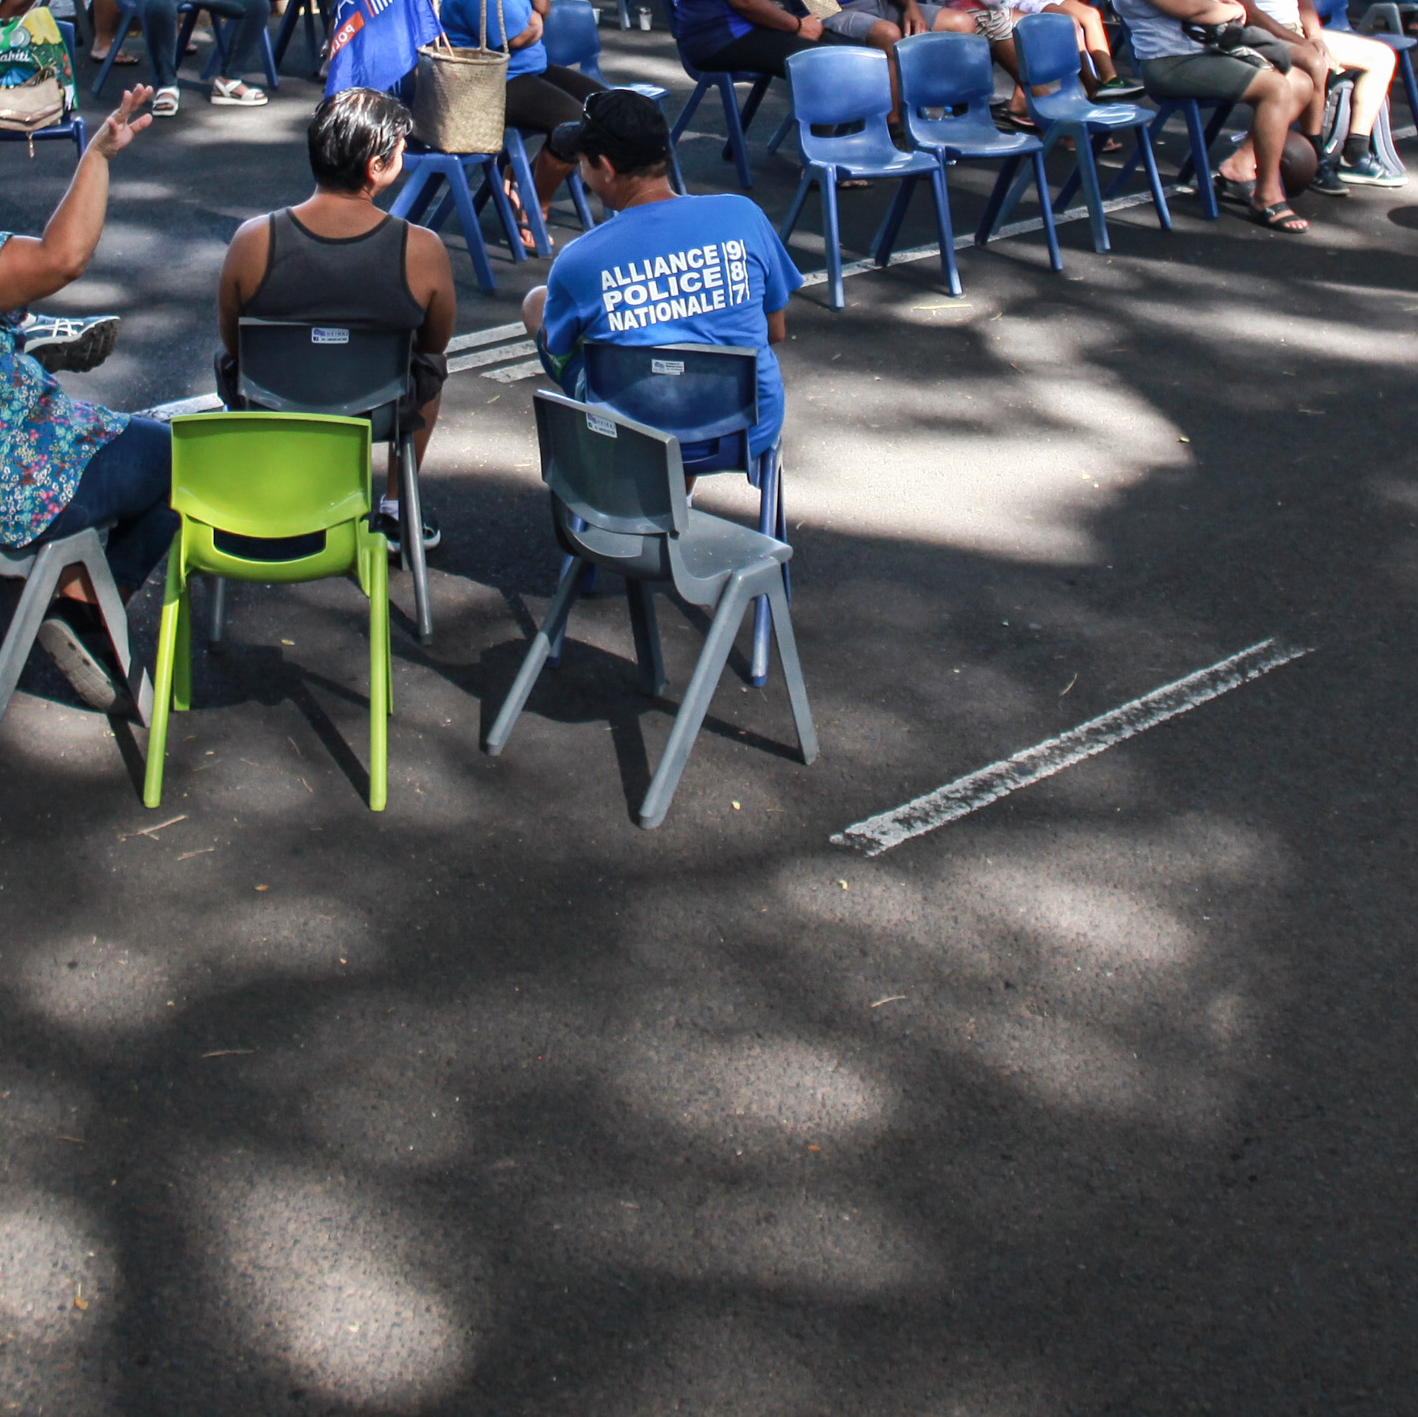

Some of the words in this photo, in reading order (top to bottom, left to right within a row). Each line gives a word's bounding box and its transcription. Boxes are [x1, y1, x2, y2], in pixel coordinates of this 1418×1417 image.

[601, 244, 721, 292] ALLIANCE
[602, 266, 725, 313] POLICE
[607, 288, 727, 332] NATIONALE
